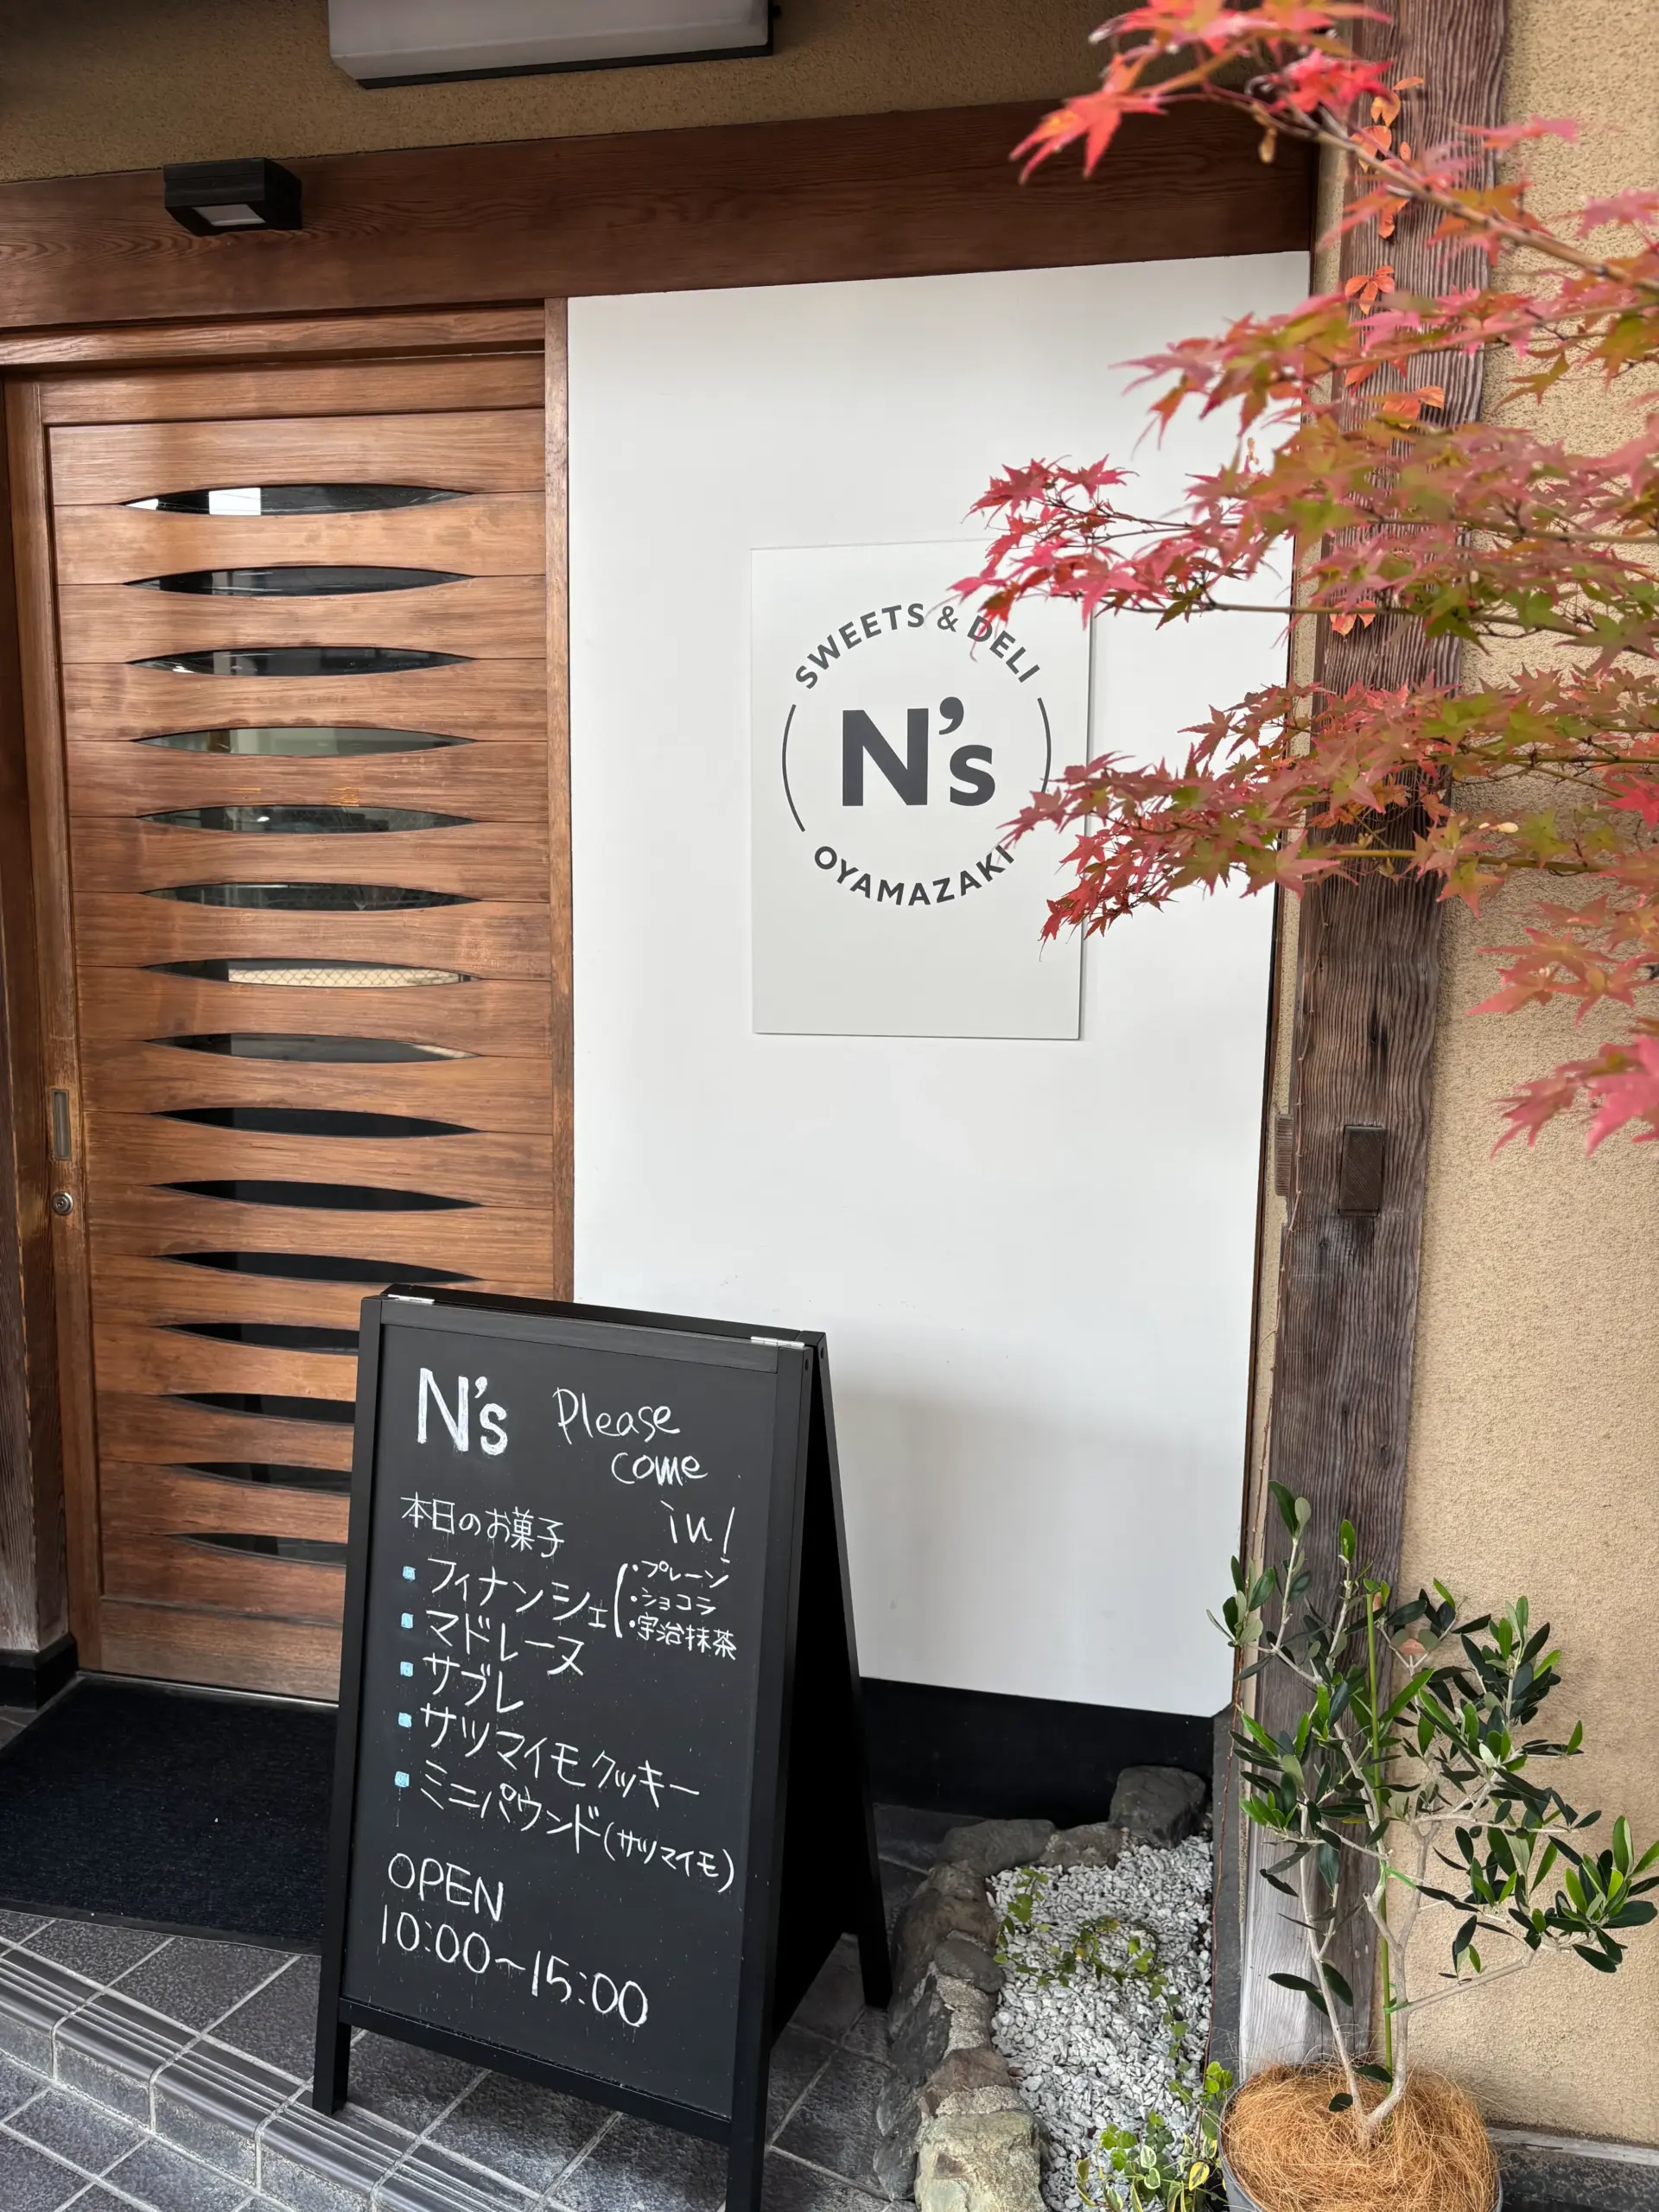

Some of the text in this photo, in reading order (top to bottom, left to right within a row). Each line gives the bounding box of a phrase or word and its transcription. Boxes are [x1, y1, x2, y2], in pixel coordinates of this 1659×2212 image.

[796, 602, 1040, 690] SWEETS & DELI
[842, 696, 995, 806] N's
[814, 844, 1015, 906] OYAMAZAKI
[417, 1367, 508, 1456] N's
[552, 1386, 681, 1445] Please
[611, 1452, 709, 1485] come
[400, 1491, 565, 1557] 本日のお菓子
[427, 1558, 608, 1629] フィナンシェ
[425, 1610, 585, 1675] マドレーヌ
[422, 1652, 524, 1713] サブレ
[388, 1853, 504, 1922] OPEN
